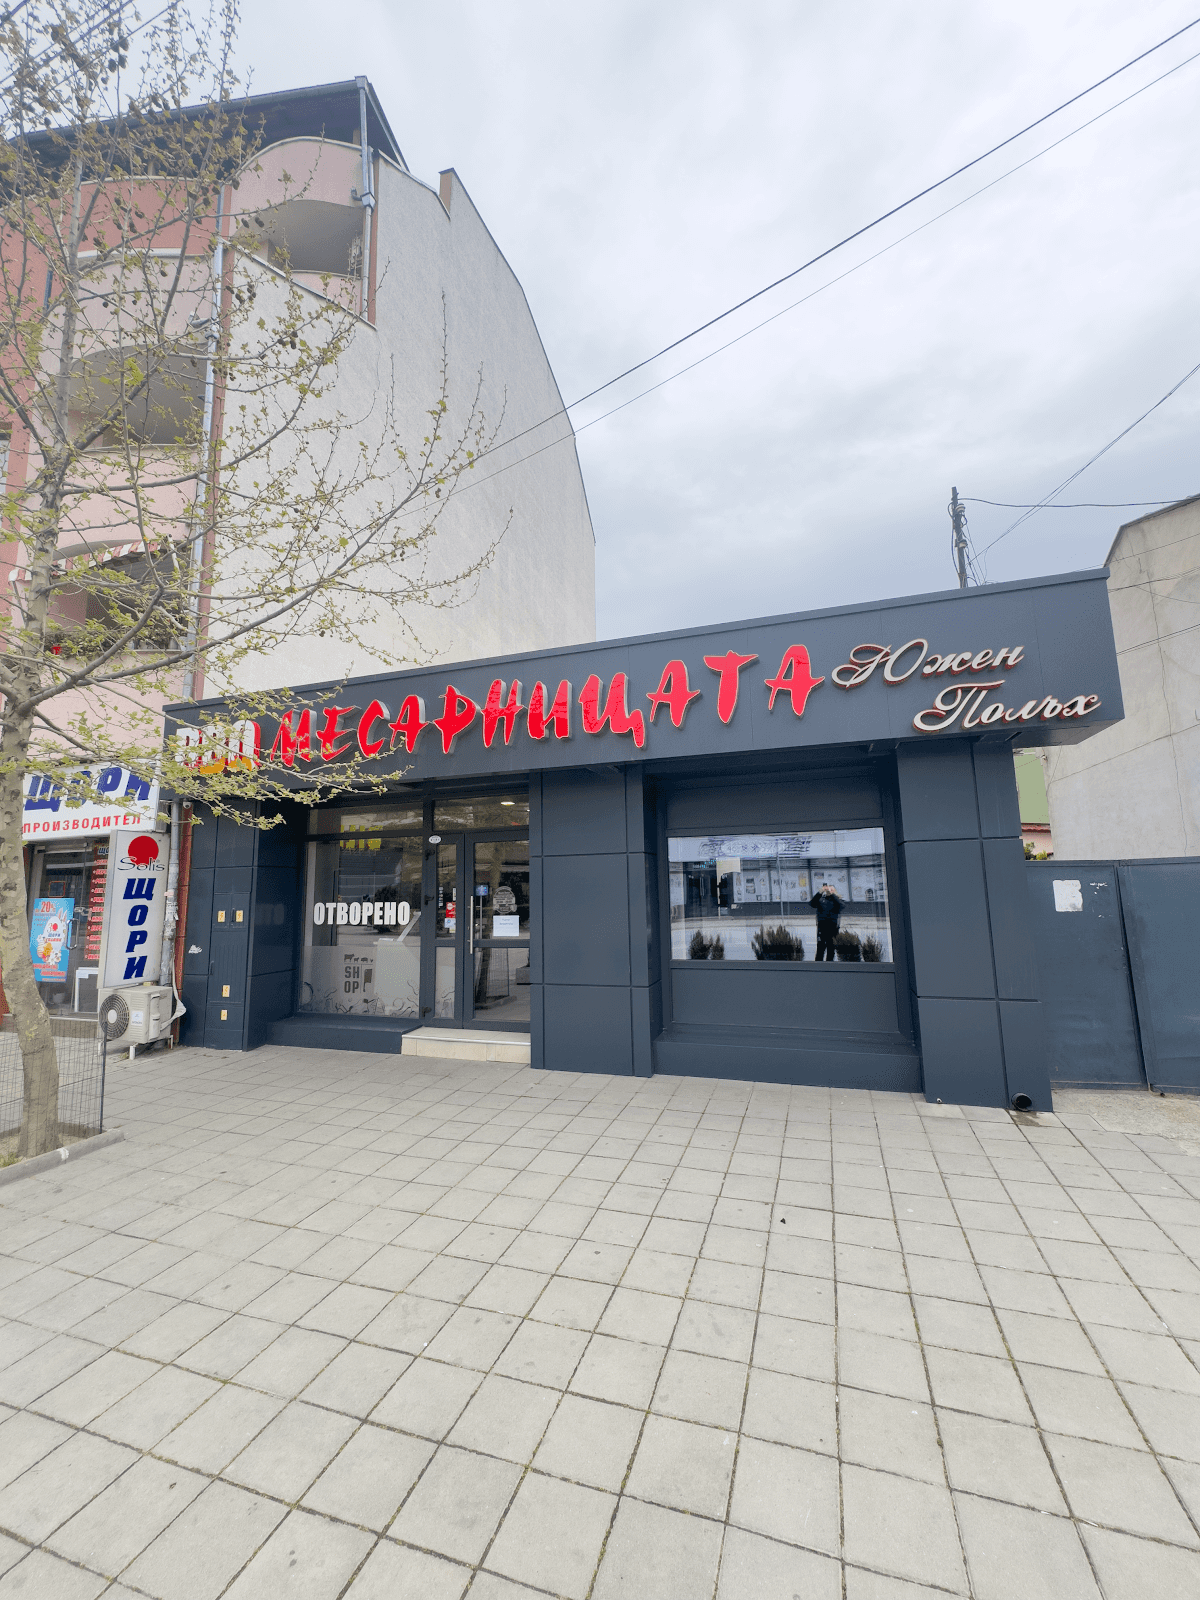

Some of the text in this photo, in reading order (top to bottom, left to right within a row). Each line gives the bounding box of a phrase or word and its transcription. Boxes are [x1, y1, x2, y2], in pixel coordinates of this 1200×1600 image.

[831, 638, 1025, 691] Южен
[269, 644, 826, 768] МЕСАРНИЦАТА
[912, 679, 1102, 734] Полъх
[22, 813, 142, 834] ПРОИЗВОДИТЕЛ
[117, 856, 165, 872] Solis
[122, 877, 157, 980] ЩОРИ
[313, 901, 411, 926] ОТВОРЕНО
